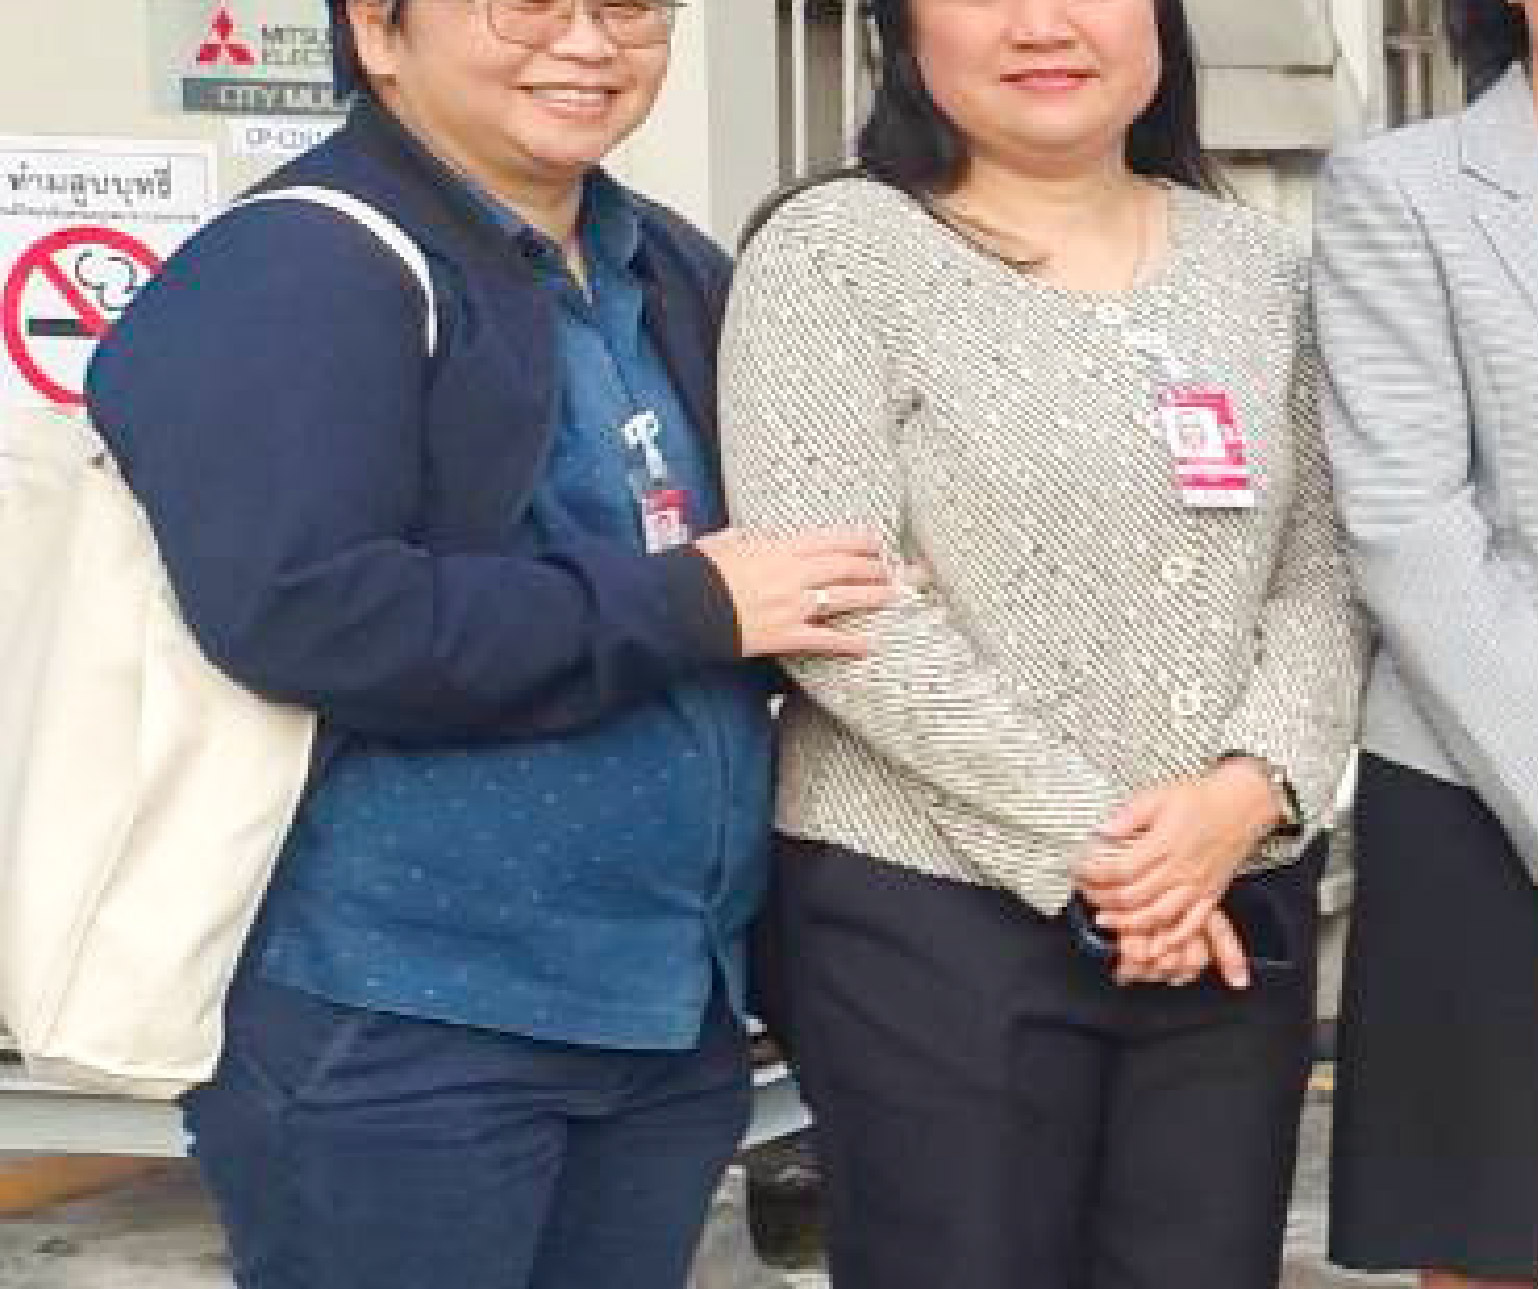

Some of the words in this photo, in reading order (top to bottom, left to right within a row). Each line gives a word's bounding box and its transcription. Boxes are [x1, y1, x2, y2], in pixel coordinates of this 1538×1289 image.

[7, 156, 172, 207] ห้ามสูบบุหรี่
